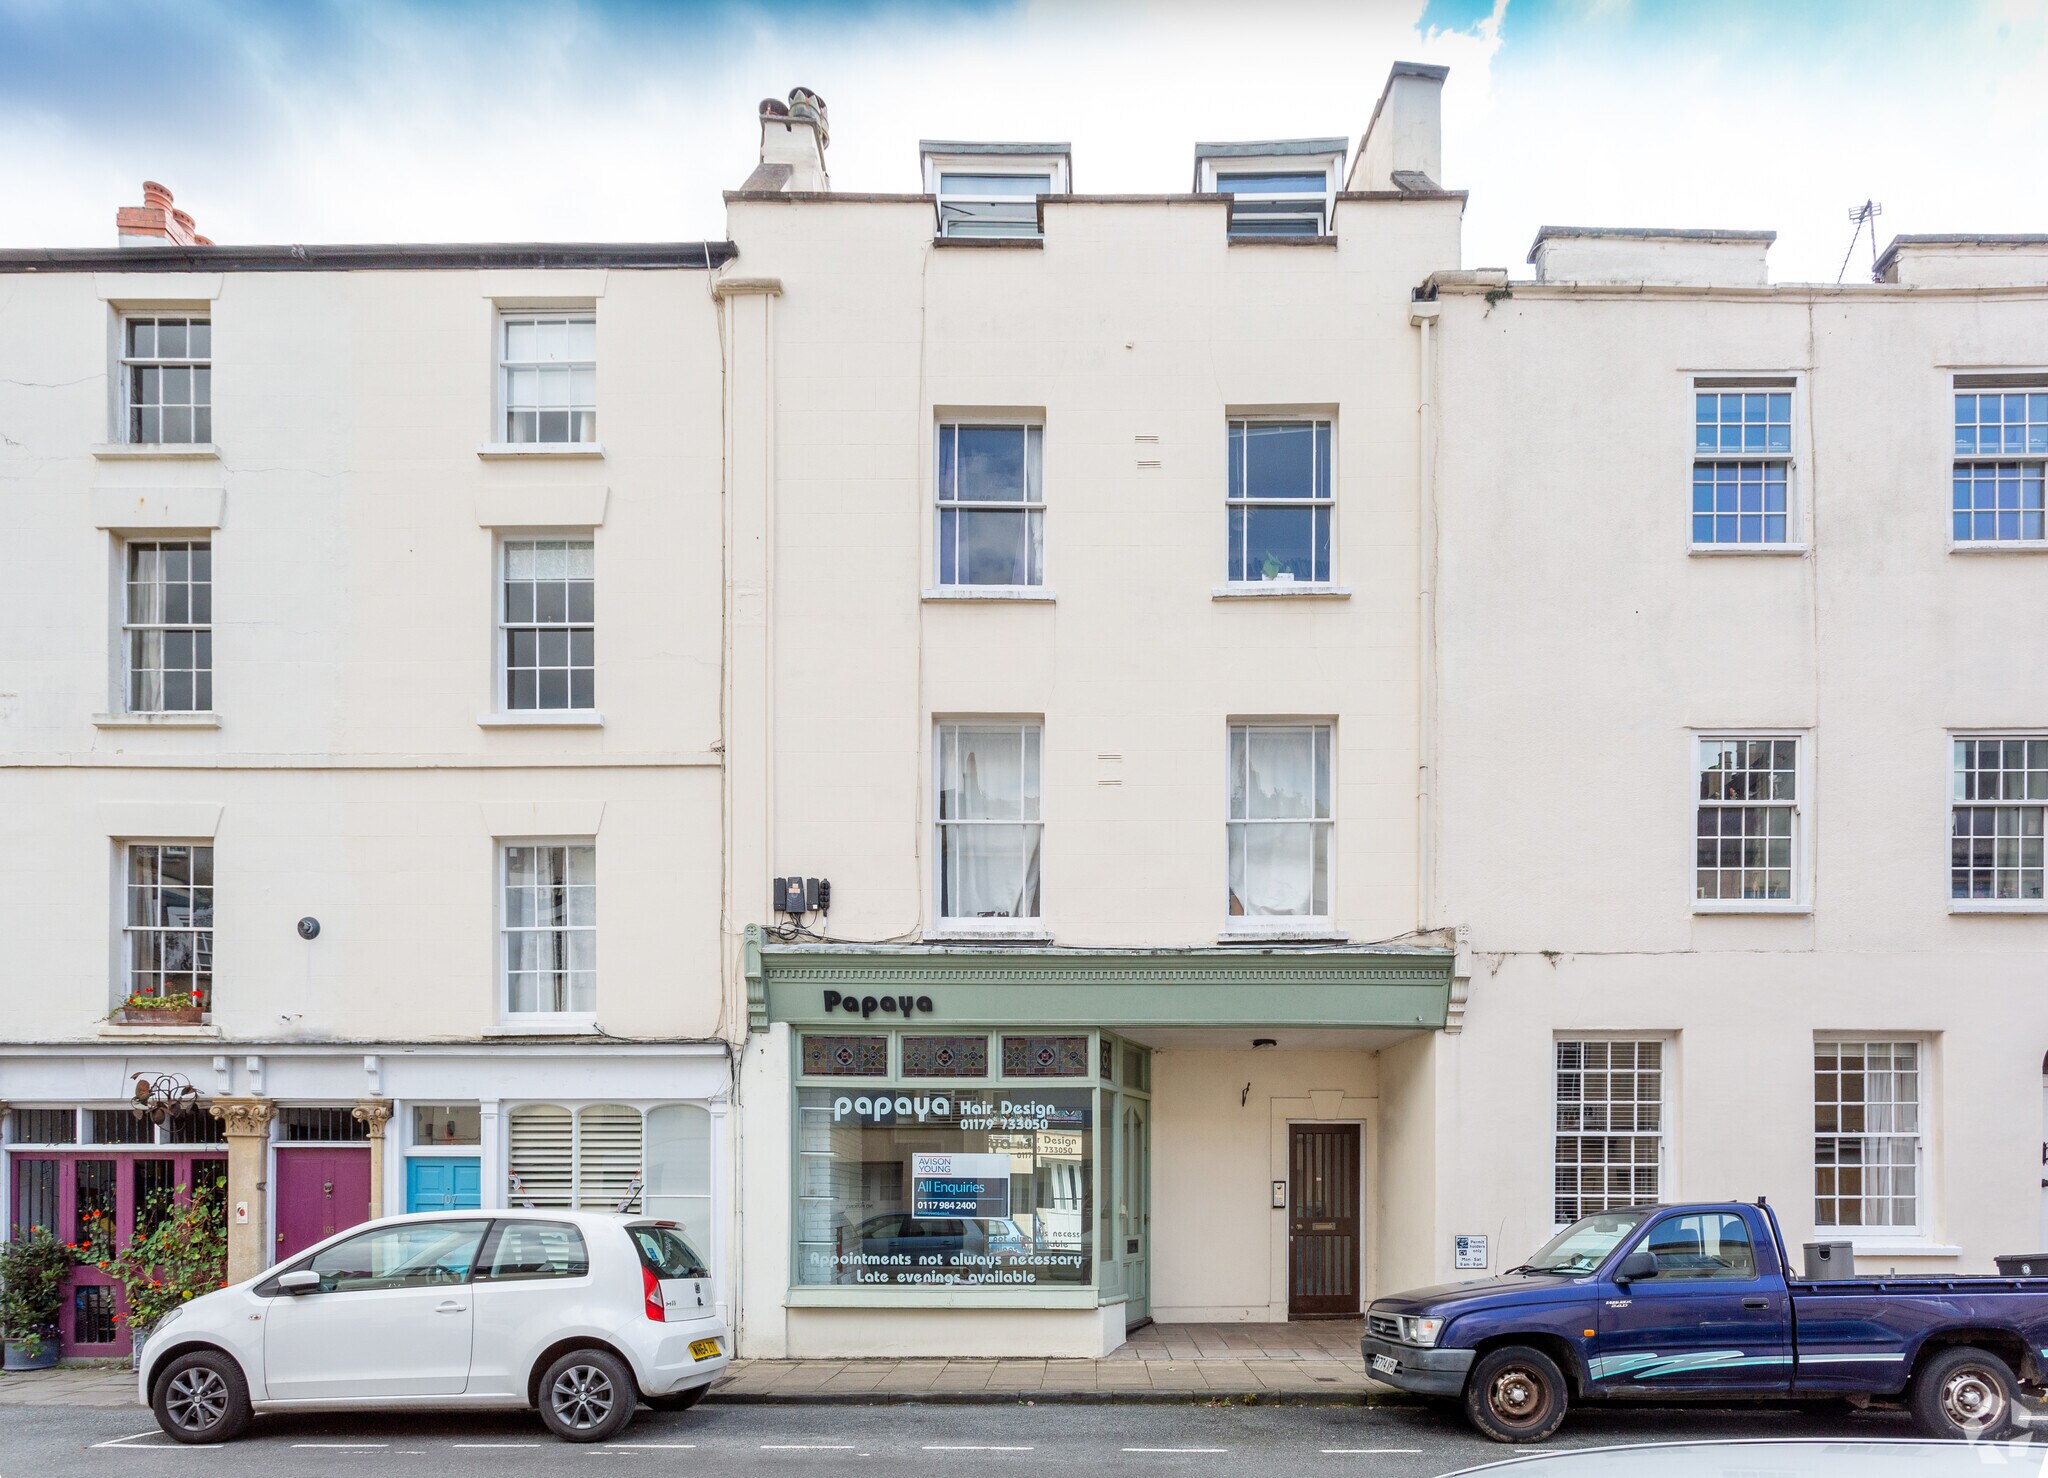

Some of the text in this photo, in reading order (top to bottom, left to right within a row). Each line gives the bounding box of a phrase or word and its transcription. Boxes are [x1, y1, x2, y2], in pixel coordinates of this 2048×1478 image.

[823, 990, 933, 1018] Papaya
[834, 1097, 1056, 1122] papaya Hair Design
[960, 1119, 1049, 1130] 01179 733050
[1044, 1136, 1077, 1147] Design
[1044, 1147, 1073, 1155] 733050
[918, 1165, 951, 1173] YOUNG
[917, 1180, 985, 1196] All Enquiries
[917, 1201, 977, 1210] 0117 984 2400
[810, 1252, 1082, 1268] Appointments not always necessary
[856, 1269, 1037, 1286] Late evenings available
